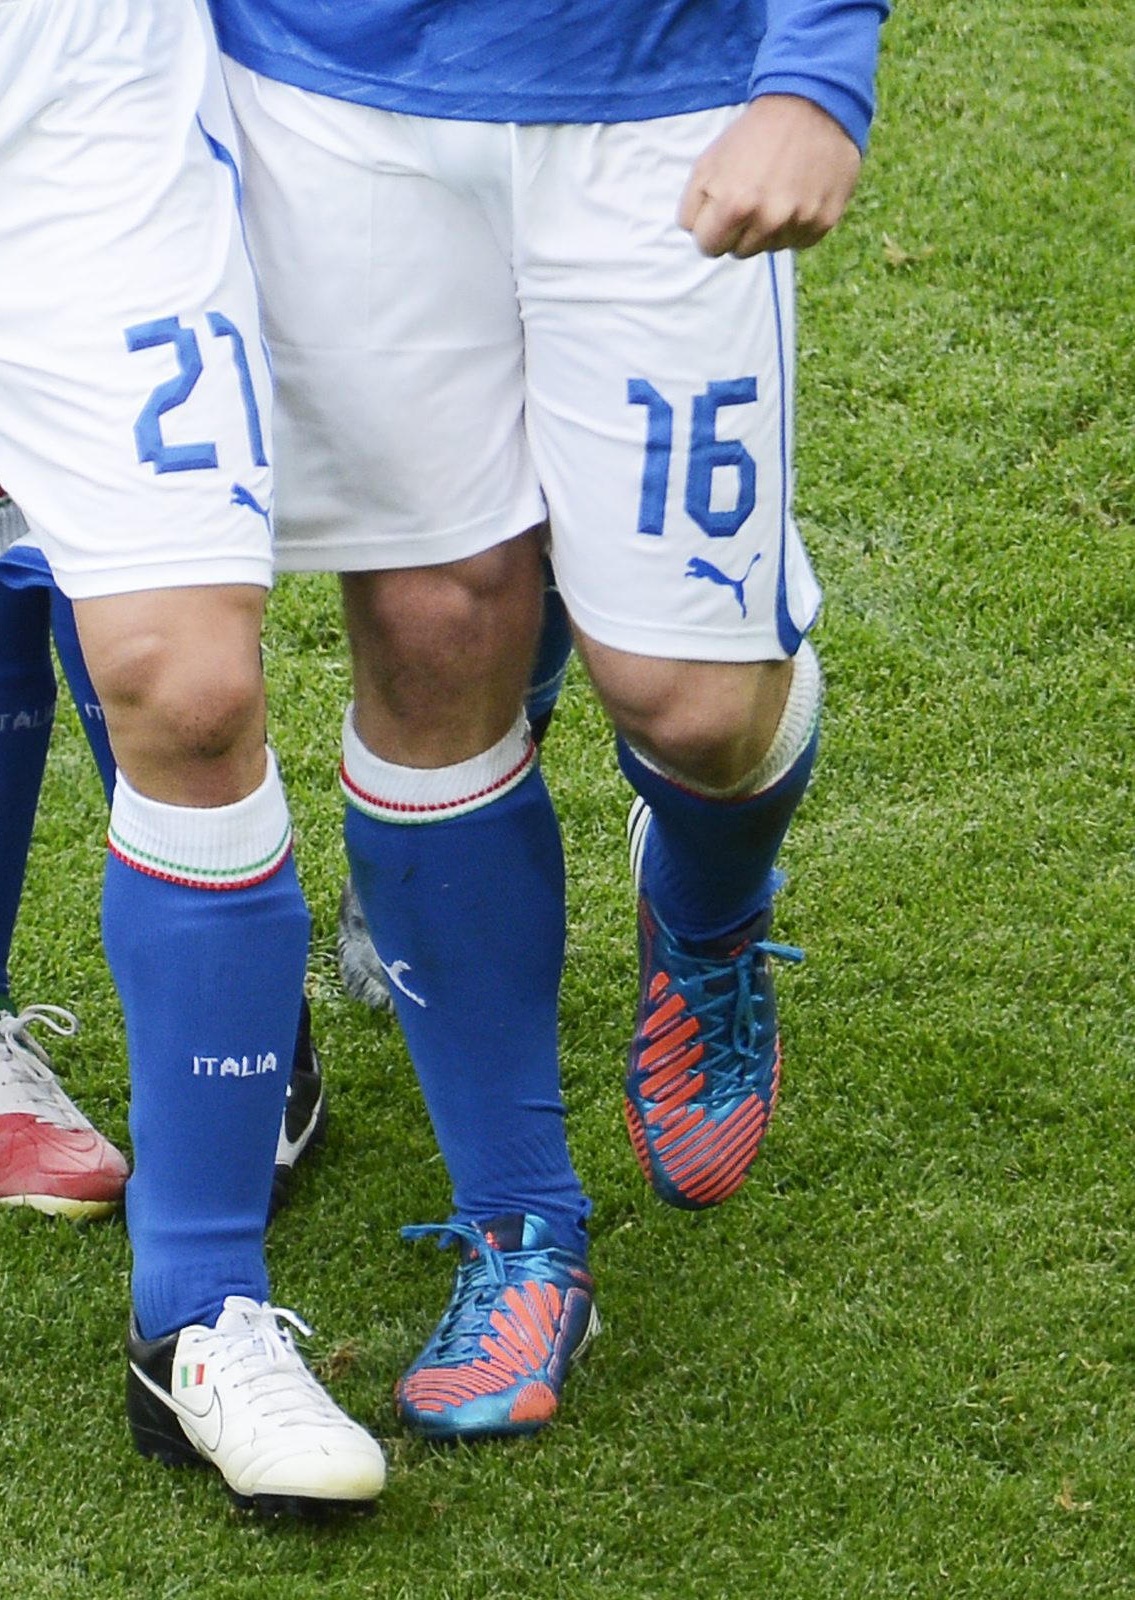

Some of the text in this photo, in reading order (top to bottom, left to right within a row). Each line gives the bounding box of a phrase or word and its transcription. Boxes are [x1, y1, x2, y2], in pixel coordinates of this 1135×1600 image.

[123, 311, 270, 476] 21
[627, 376, 758, 538] 16
[193, 1052, 277, 1077] ITALIA
